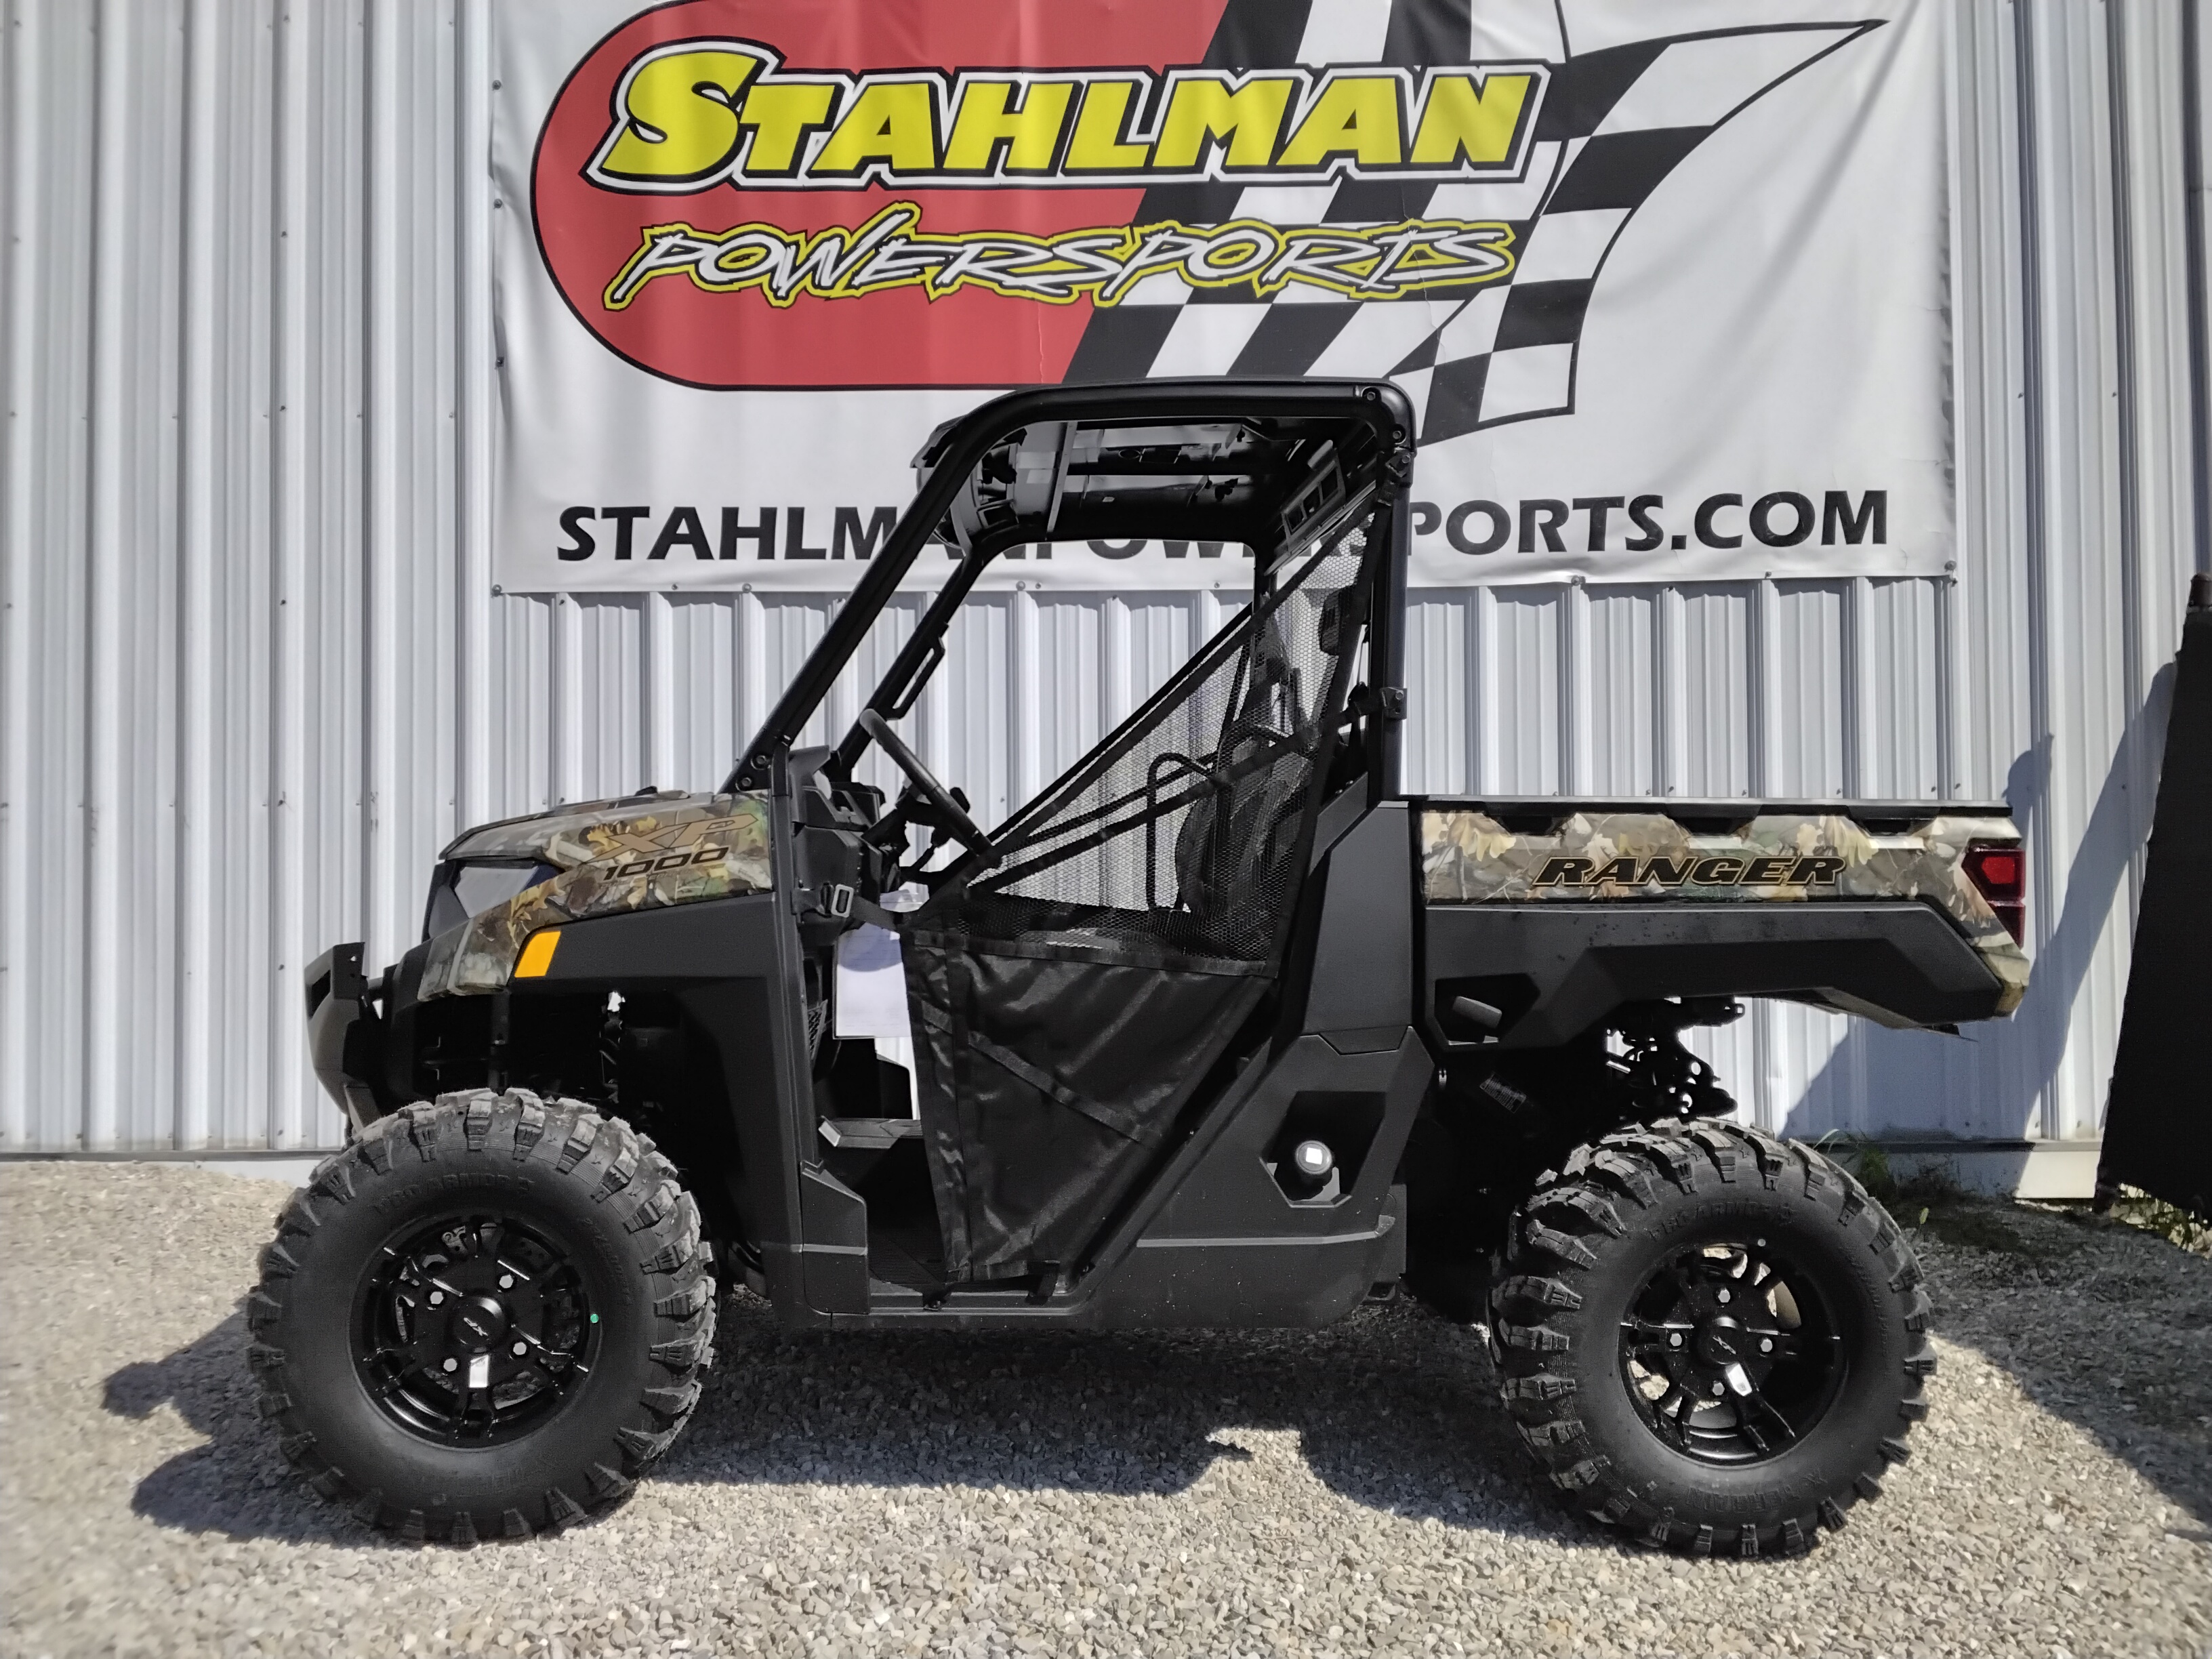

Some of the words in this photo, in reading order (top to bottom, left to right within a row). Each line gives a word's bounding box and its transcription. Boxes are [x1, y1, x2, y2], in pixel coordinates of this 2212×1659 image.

[587, 41, 1551, 190] STAHLMAN
[609, 207, 1510, 304] POWERSPORTS
[580, 813, 758, 865] XP
[603, 846, 729, 880] 1000
[1531, 855, 1846, 887] RANGER
